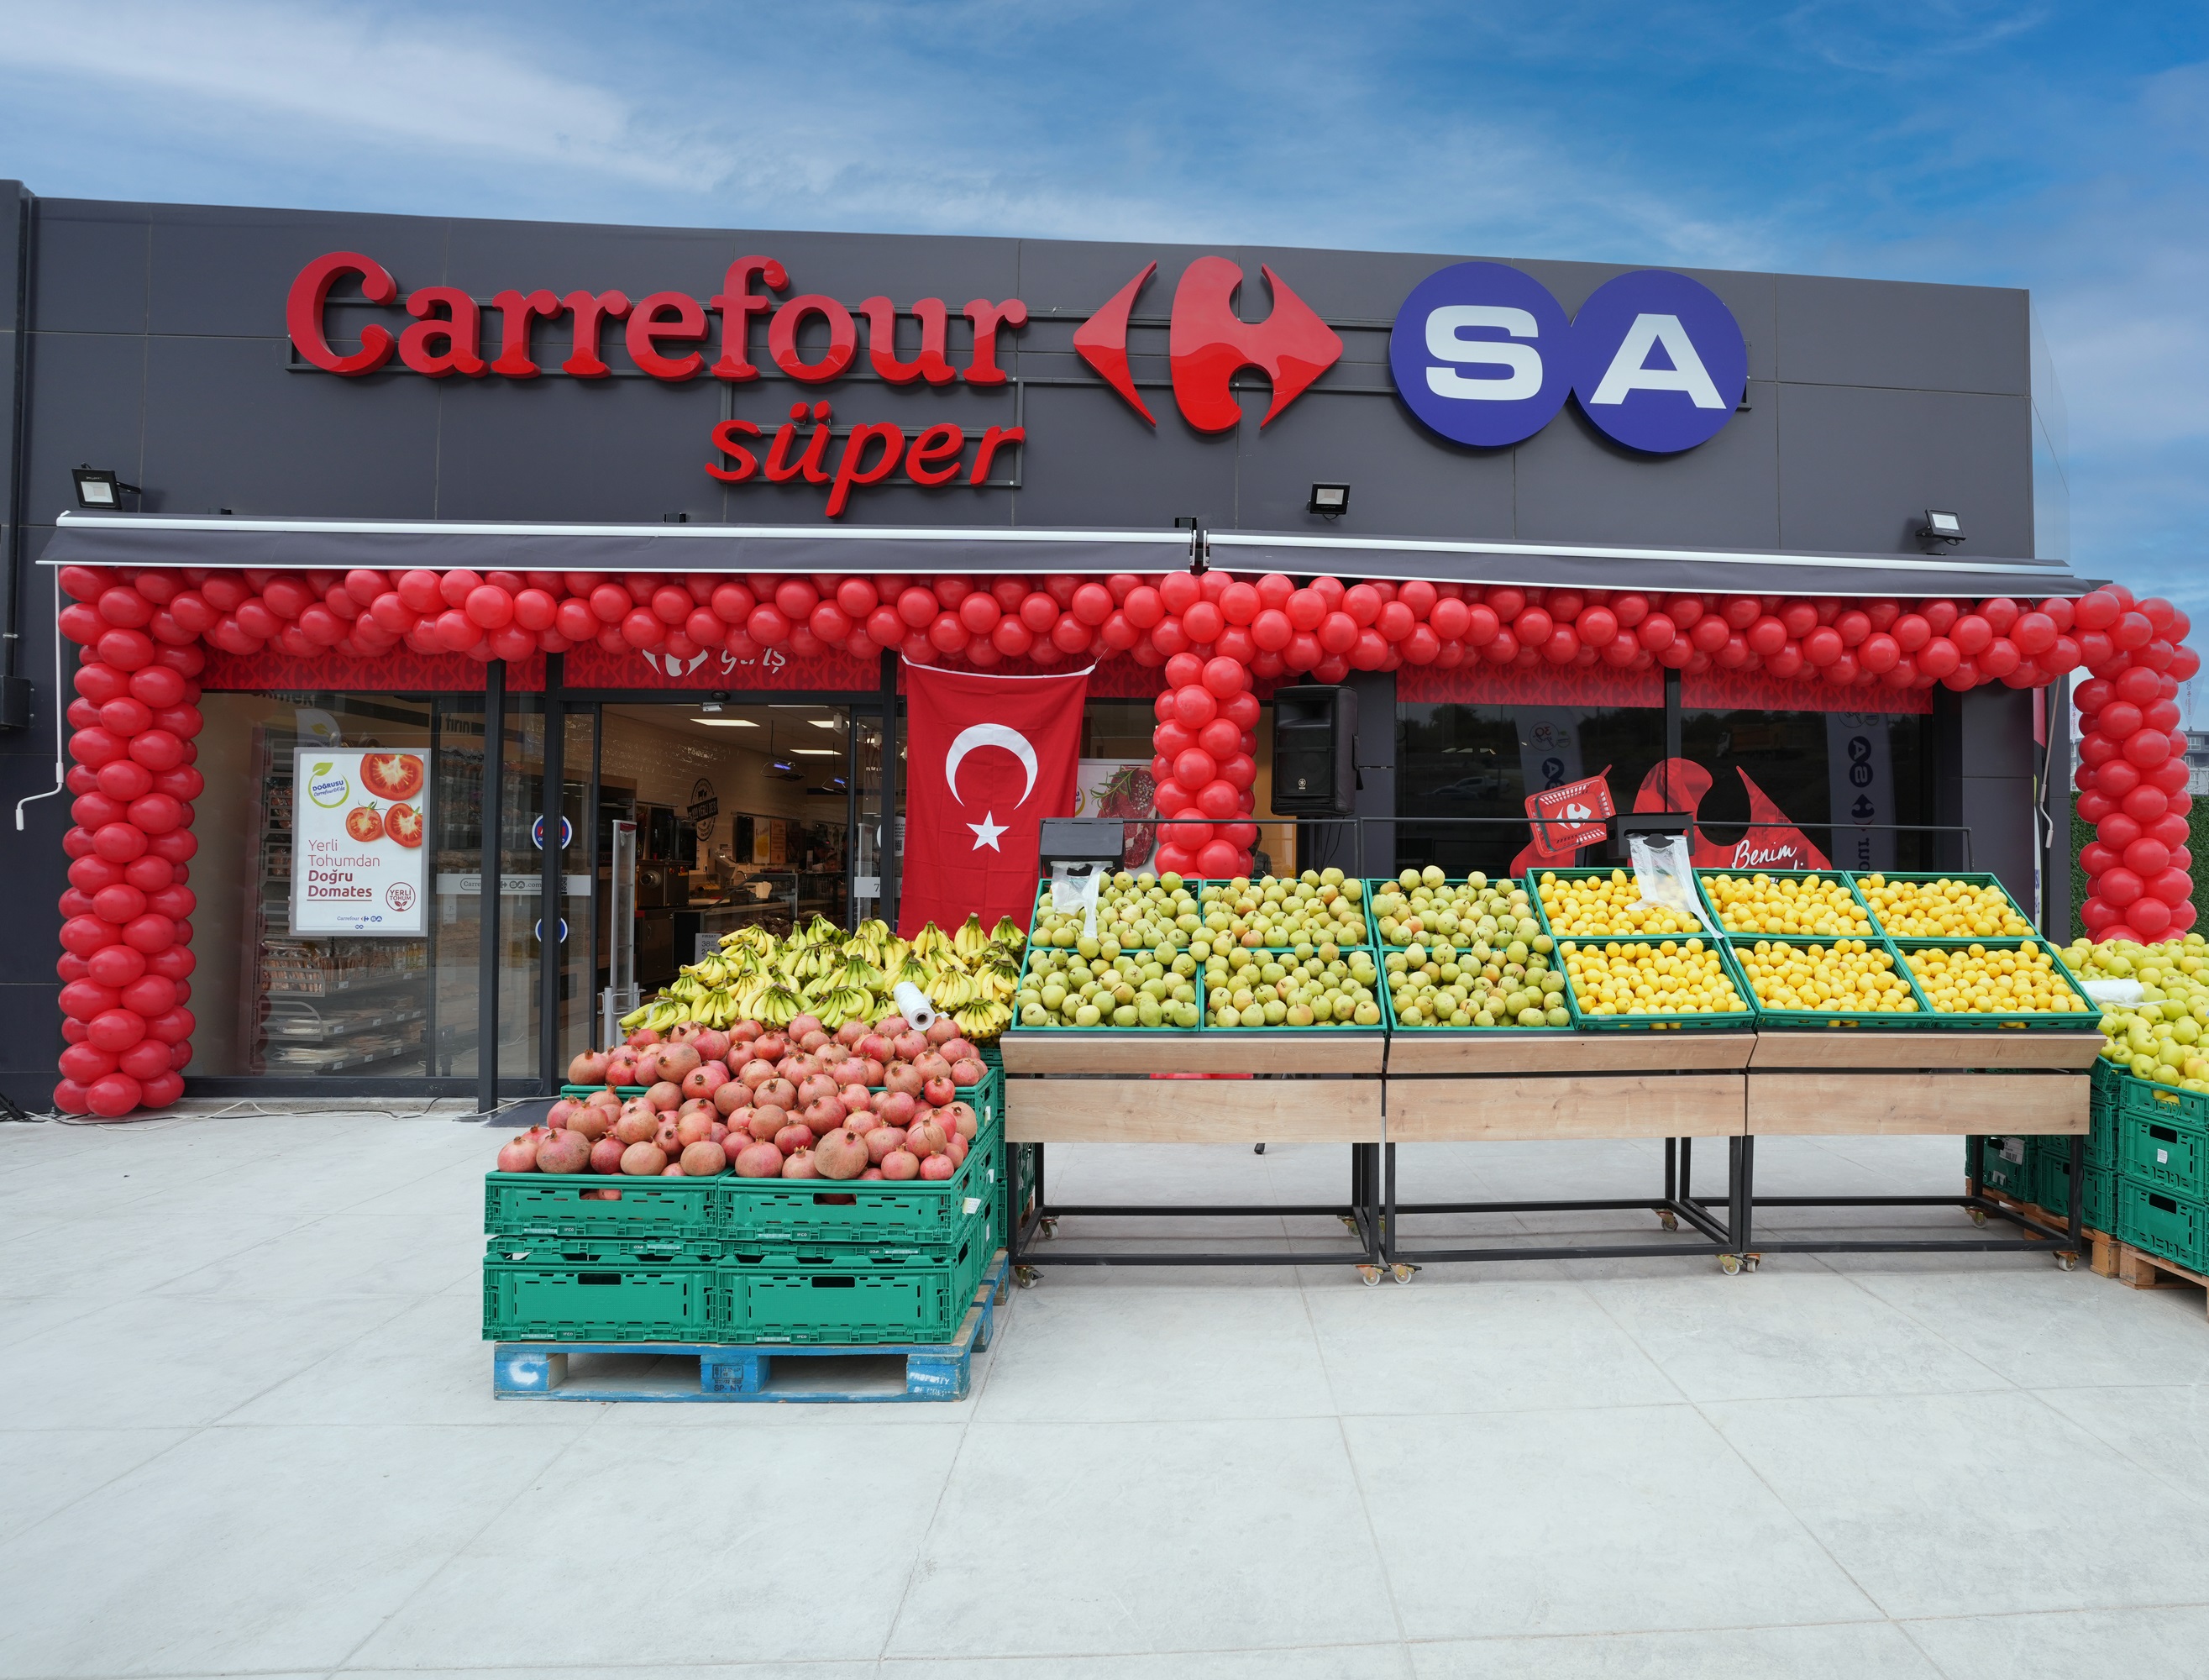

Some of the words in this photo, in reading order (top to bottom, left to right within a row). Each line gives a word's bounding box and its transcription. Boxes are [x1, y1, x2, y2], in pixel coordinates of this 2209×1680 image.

[286, 250, 1027, 386] Carrefour
[705, 400, 1026, 518] süper
[312, 780, 344, 792] DOĞRUSU
[308, 839, 338, 852] Yerli
[307, 853, 380, 867] Tohumdan
[1731, 839, 1797, 869] Benim
[307, 869, 353, 885] Doğru
[307, 885, 372, 898] Domates
[390, 888, 412, 896] YERLİ
